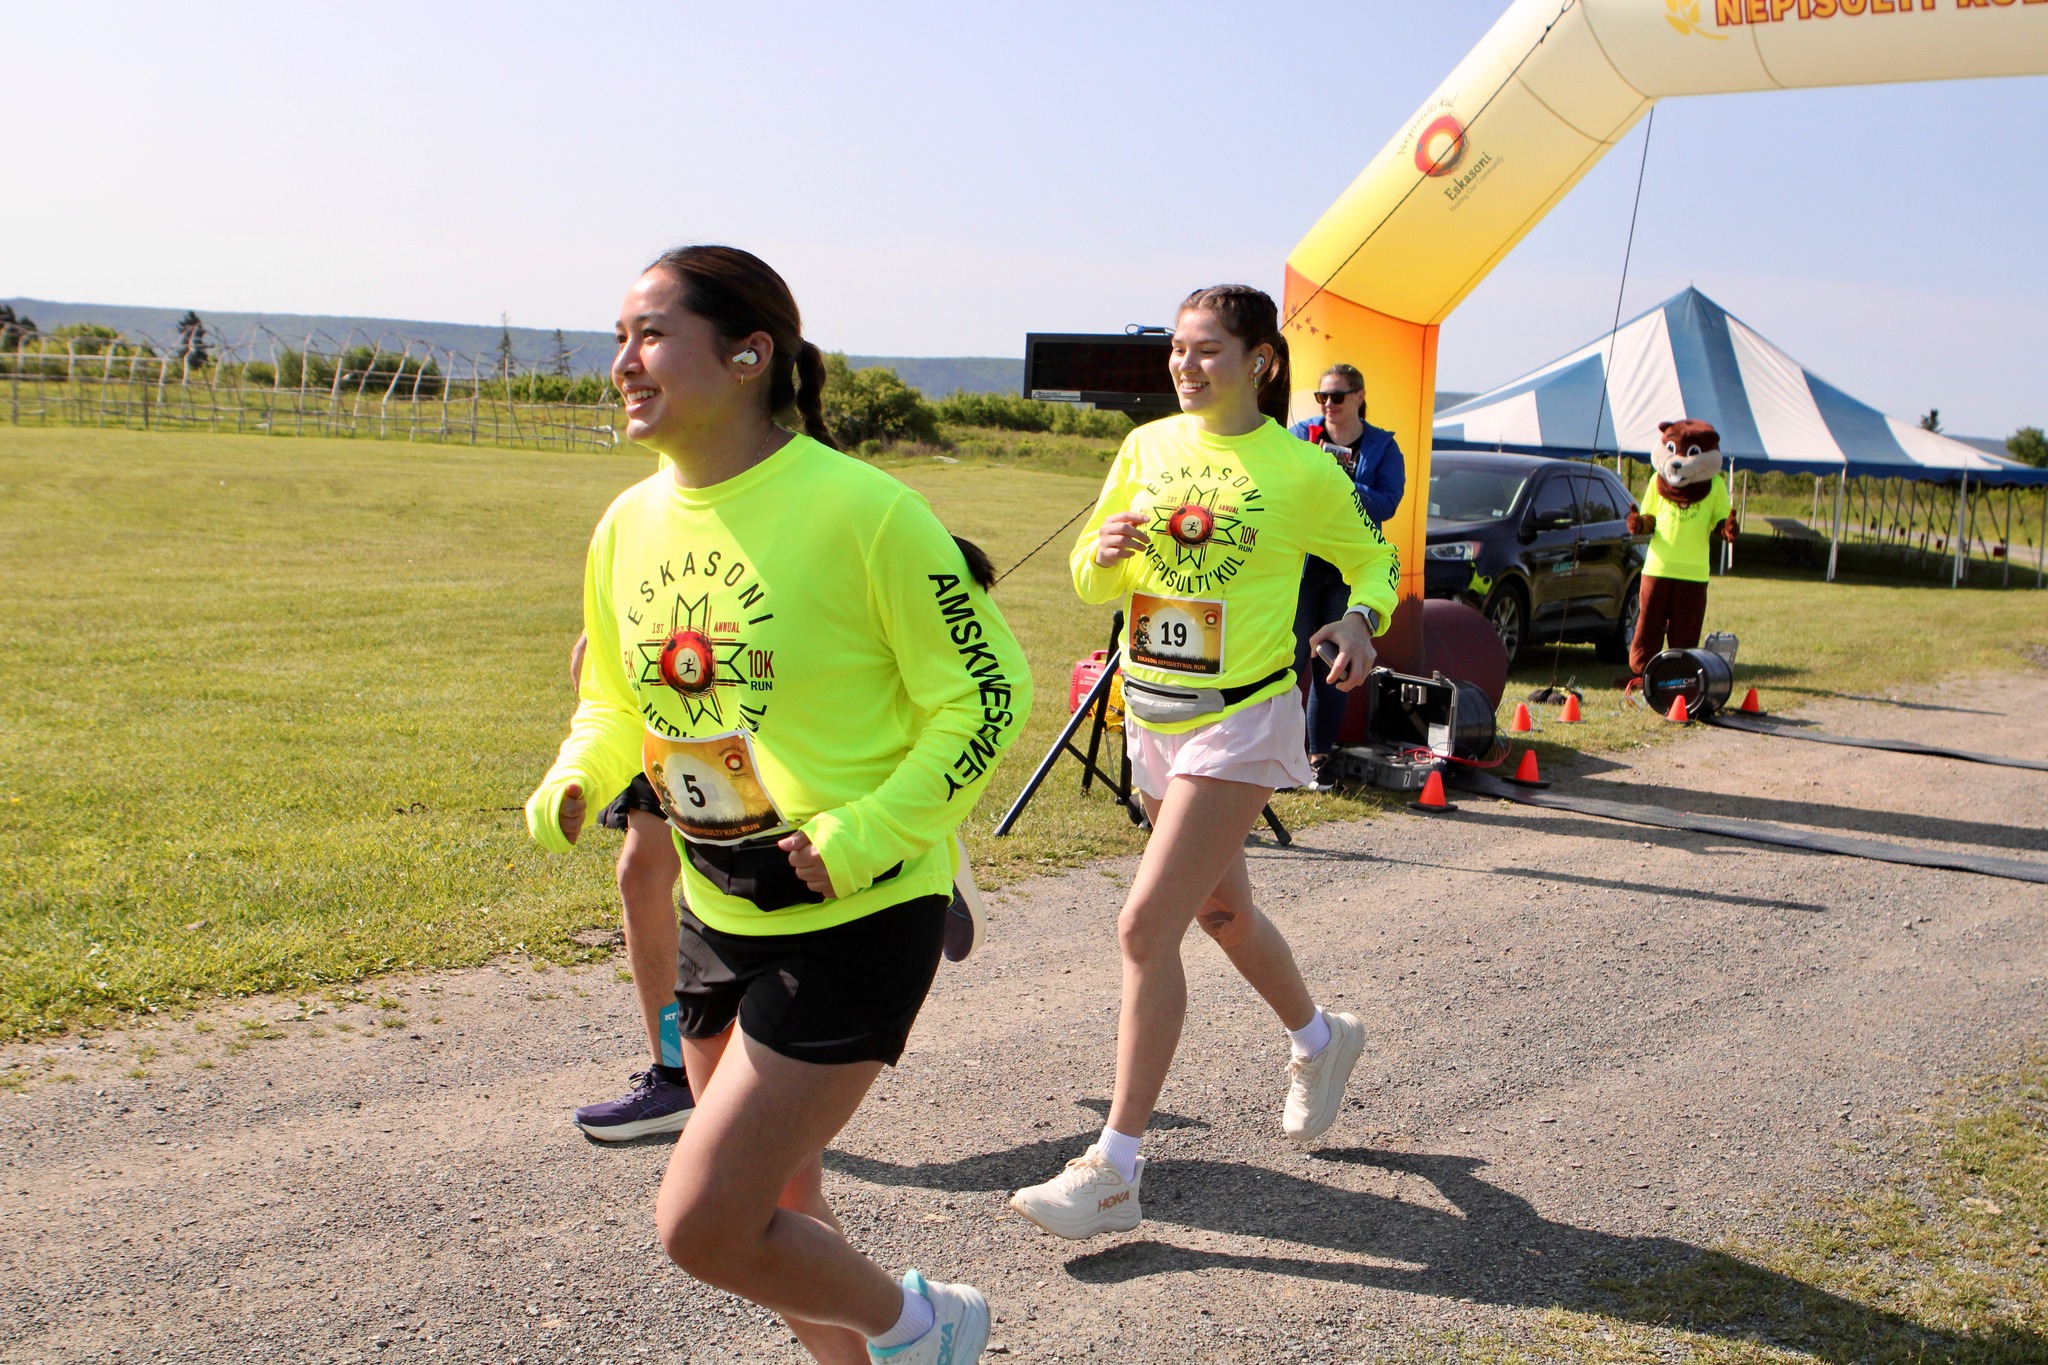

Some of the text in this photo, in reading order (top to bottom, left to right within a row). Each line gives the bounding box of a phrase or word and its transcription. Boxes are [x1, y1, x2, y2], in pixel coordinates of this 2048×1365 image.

[1444, 151, 1493, 201] Eskasoni
[1146, 465, 1265, 512] ESKASONI
[1218, 504, 1239, 514] ANNUAL
[1239, 525, 1259, 547] 10K
[1237, 544, 1253, 554] RUN
[627, 550, 775, 627] ESKASONI
[652, 621, 741, 634] 1ST ANNUAL
[1161, 621, 1187, 648] 19
[747, 649, 775, 679] 10K
[750, 681, 773, 691] RUN
[682, 773, 706, 808] 5
[741, 822, 761, 833] RUN
[1097, 1190, 1130, 1213] HOKA
